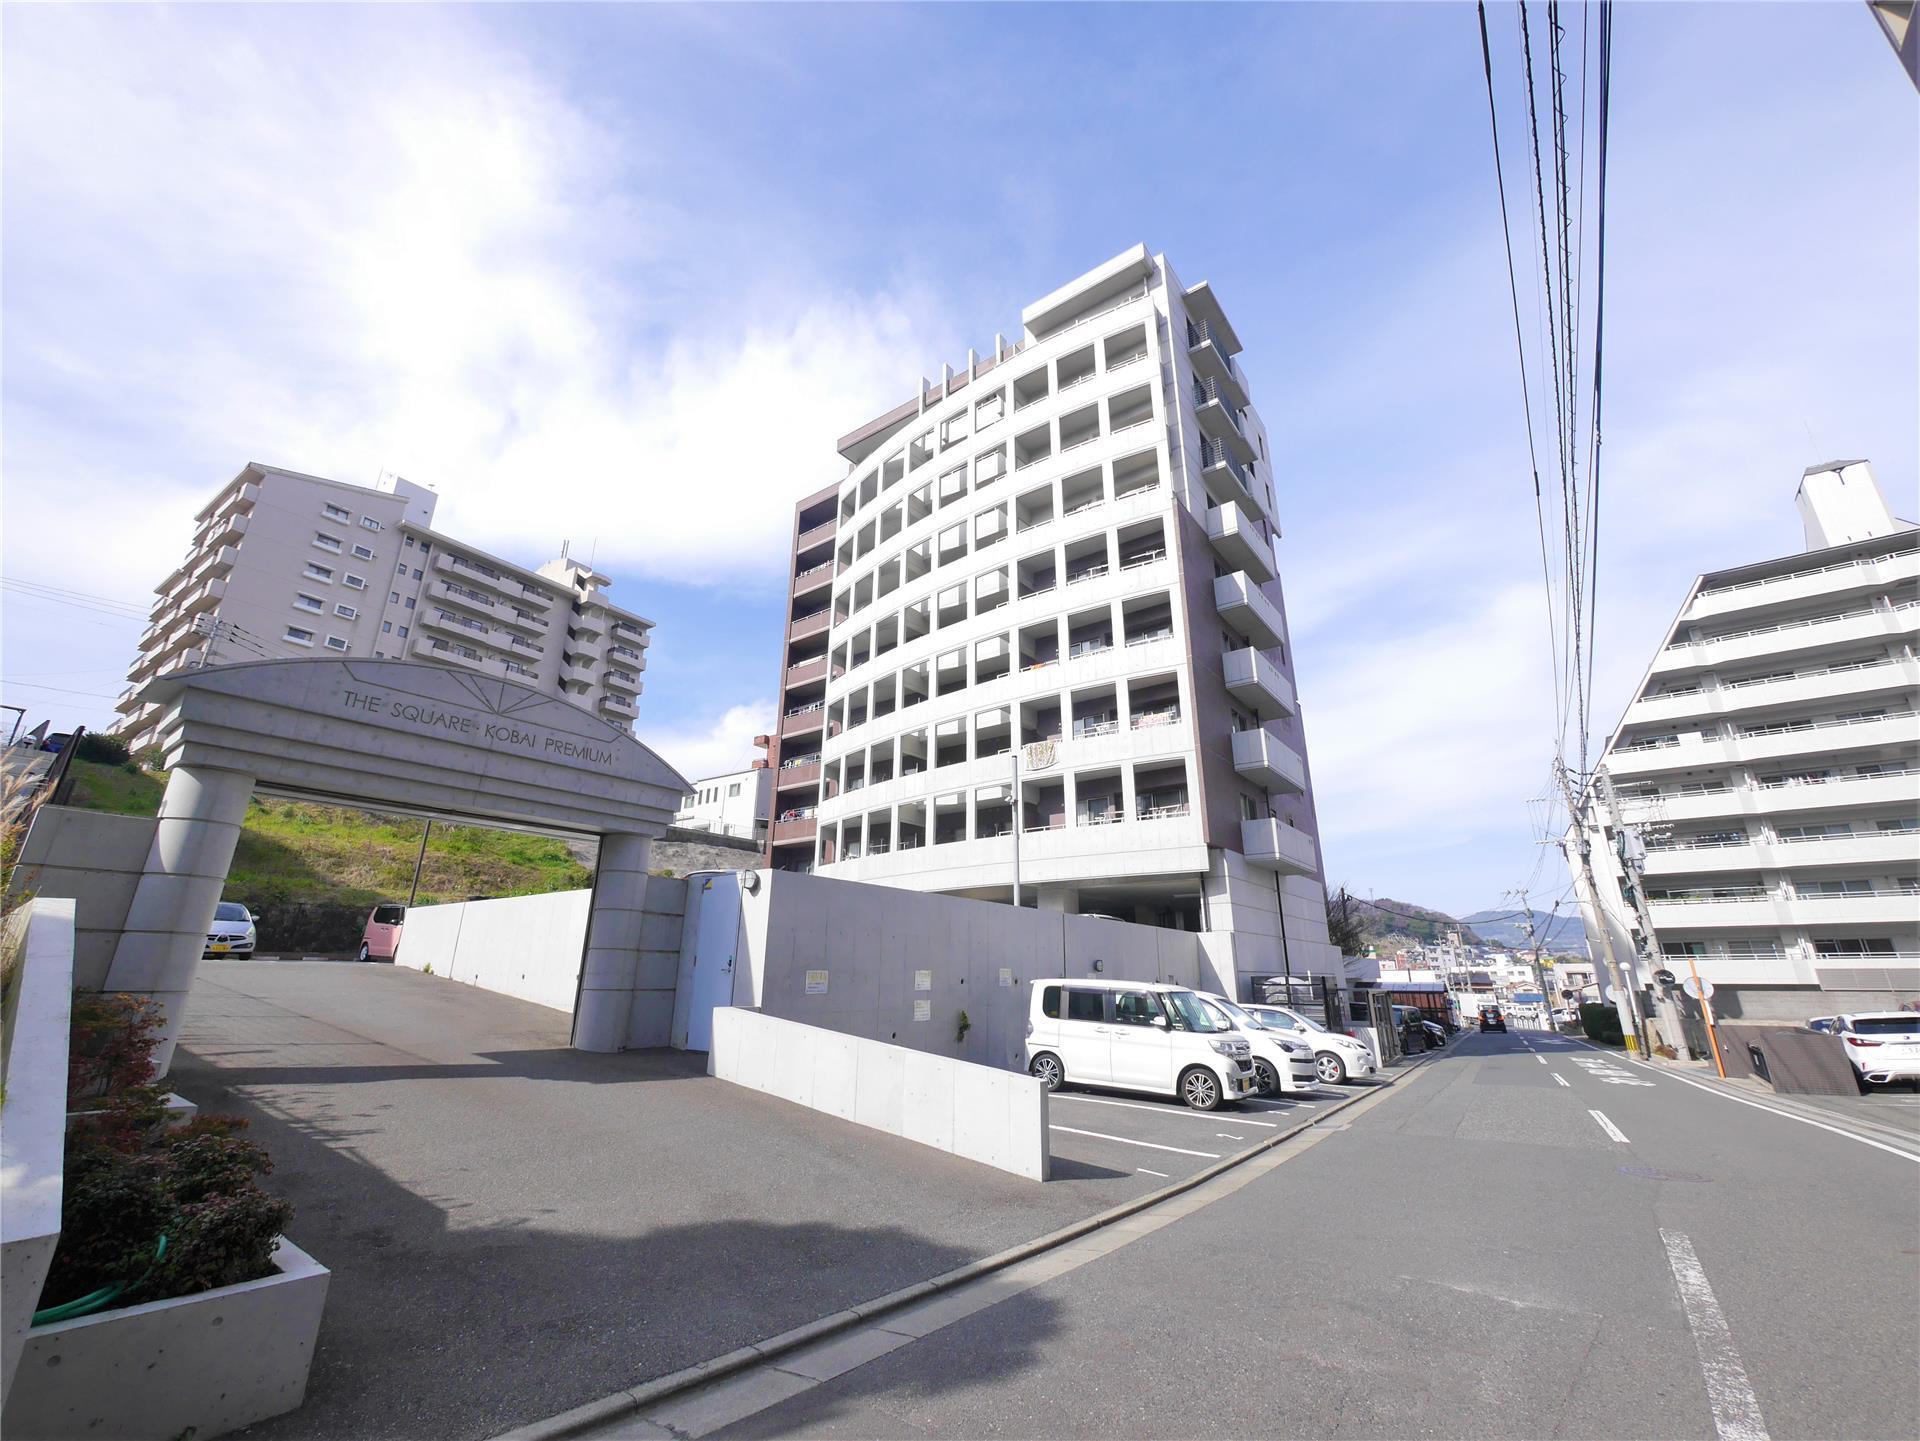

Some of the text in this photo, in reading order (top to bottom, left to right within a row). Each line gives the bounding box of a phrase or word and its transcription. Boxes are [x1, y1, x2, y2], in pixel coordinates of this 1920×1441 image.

[344, 690, 612, 766] THE SQUARE KOBAI PREMIUM
